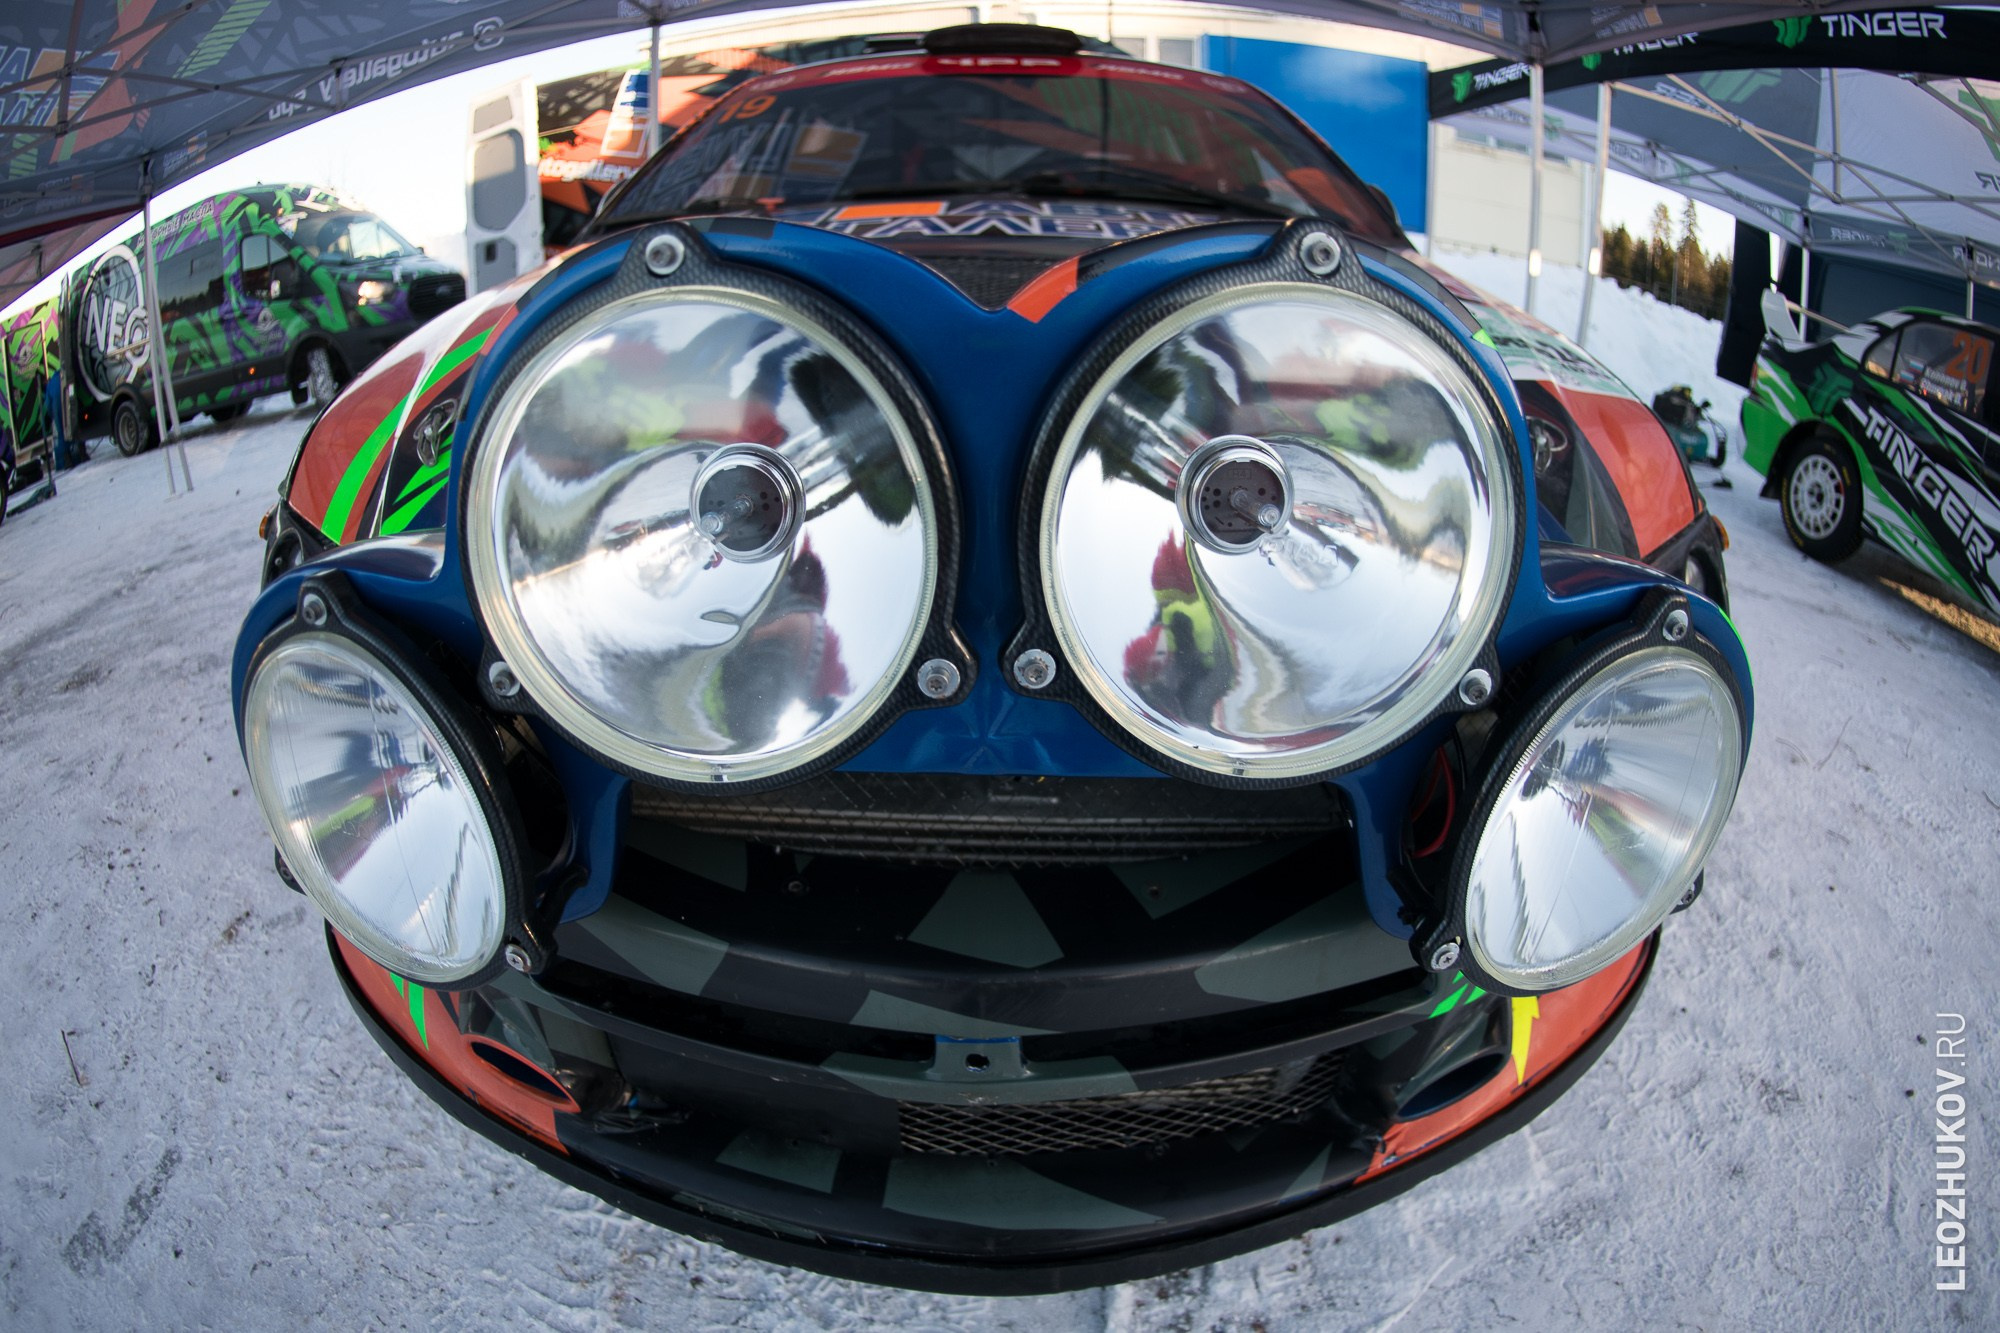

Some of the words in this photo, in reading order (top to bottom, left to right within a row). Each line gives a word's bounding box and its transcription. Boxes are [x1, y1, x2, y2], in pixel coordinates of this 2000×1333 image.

[1821, 12, 1948, 39] TINGER
[1473, 62, 1531, 91] TINGER
[718, 96, 777, 124] 19
[1946, 331, 1990, 383] 20
[1865, 406, 1994, 573] TINGER
